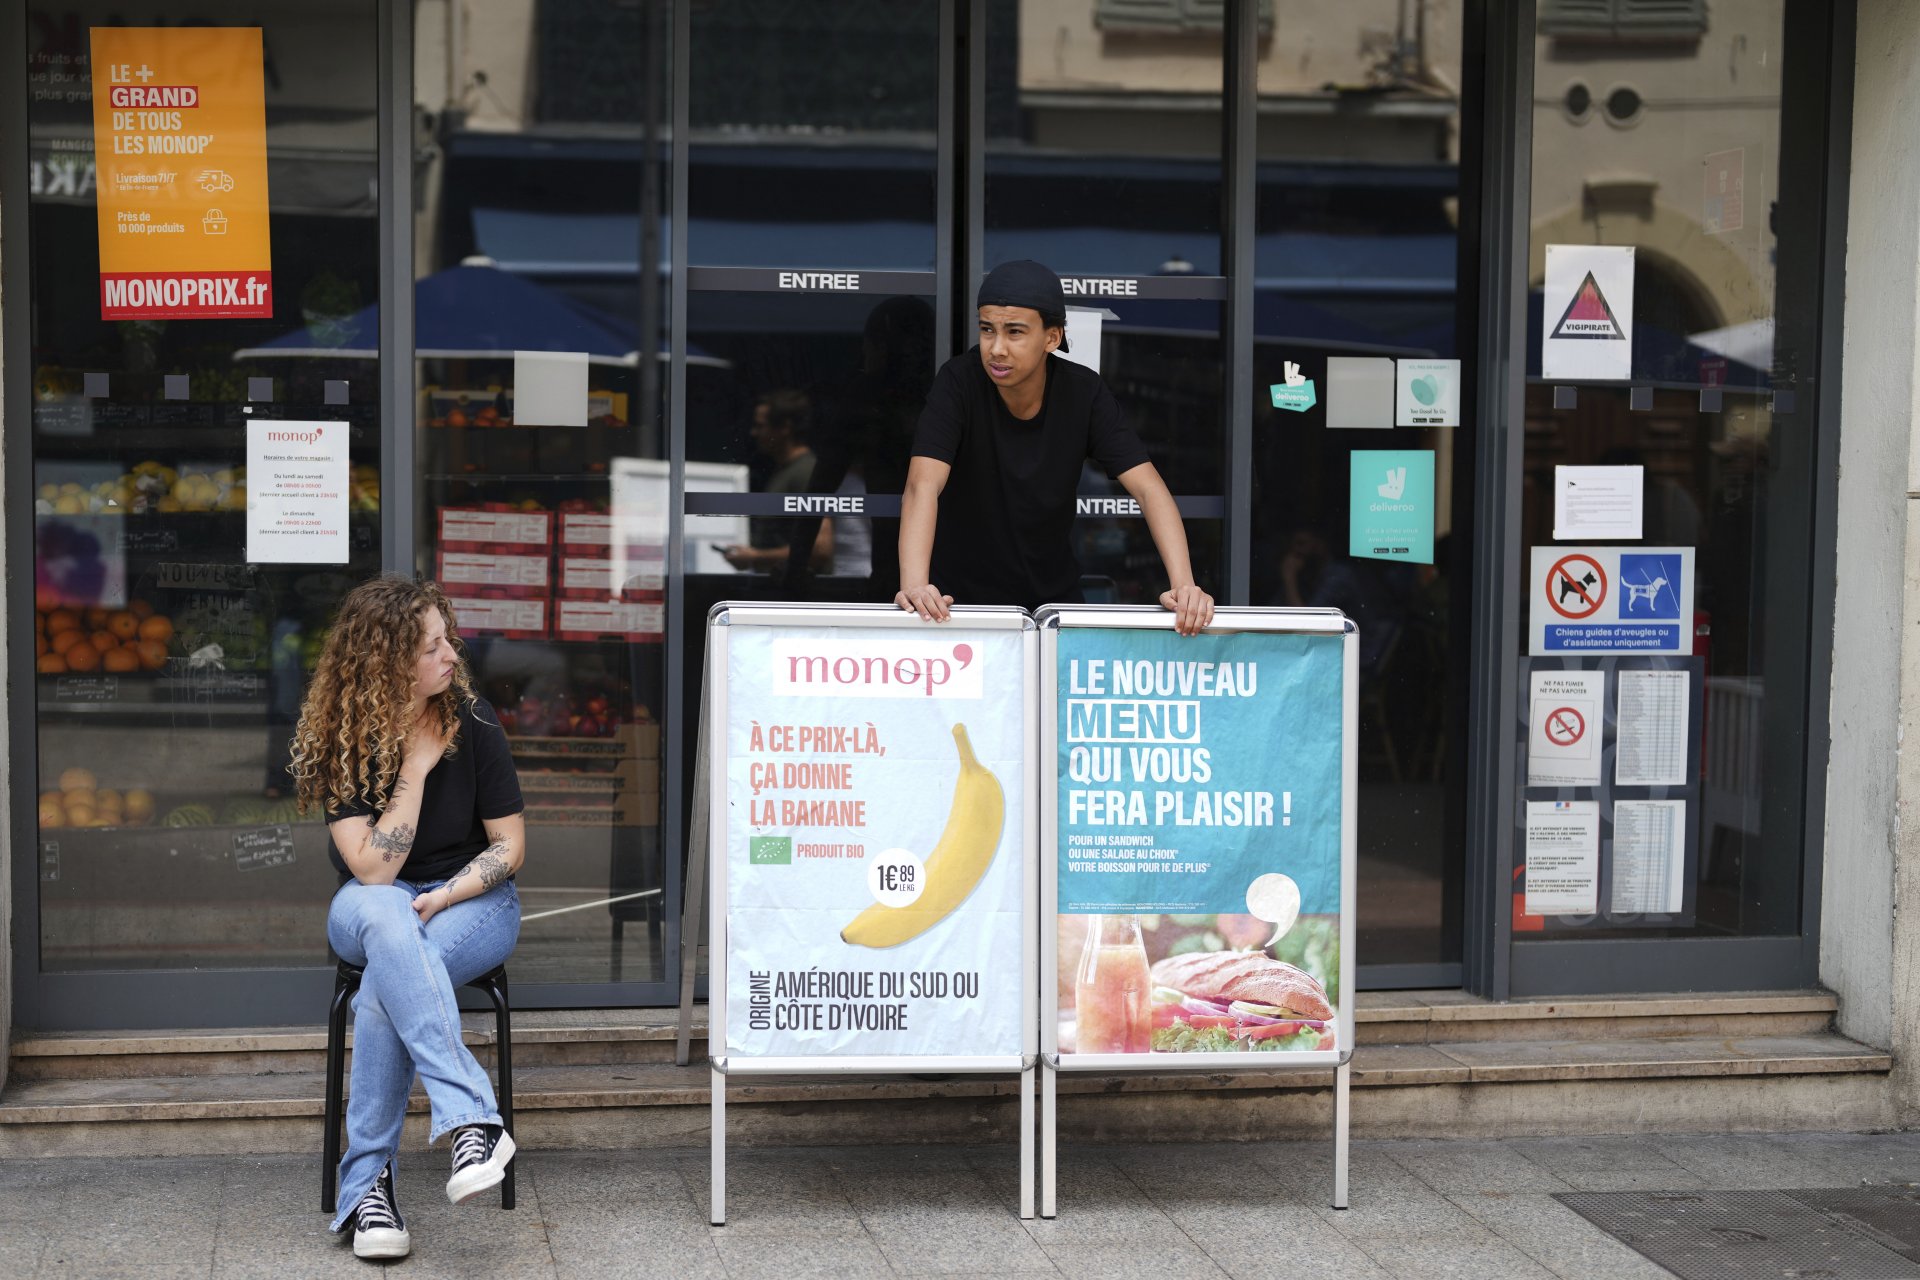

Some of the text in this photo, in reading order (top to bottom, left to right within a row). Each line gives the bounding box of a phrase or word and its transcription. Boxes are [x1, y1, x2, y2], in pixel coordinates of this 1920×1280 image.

[37, 52, 70, 64] fruits
[111, 64, 154, 82] LE +
[112, 87, 197, 107] GRAND
[113, 112, 182, 131] DE TOUS
[114, 135, 145, 155] LES
[116, 172, 158, 184] Livraison
[118, 211, 150, 222] Près de
[118, 222, 184, 236] 10 000 produits
[779, 272, 860, 290] ENTREE
[1060, 278, 1138, 296] ENTREE
[105, 276, 268, 308] MONOPRIX.fr
[1275, 392, 1310, 402] deliveroo
[784, 496, 864, 512] ENTREE
[1076, 498, 1142, 514] NTREE
[1370, 502, 1414, 512] deliveroo
[1556, 628, 1584, 636] Chiens
[1586, 628, 1612, 638] guides
[1614, 628, 1657, 638] d'aveugles
[1563, 638, 1661, 648] d'assistance uniquement
[1070, 659, 1257, 697] LE NOUVEAU
[1070, 702, 1198, 740] MENU
[750, 720, 886, 757] À CE PRIX-LÀ,
[1068, 746, 1212, 785] QUI VOUS
[750, 762, 852, 796] ÇA DONNE
[750, 799, 866, 827] LA BANANE
[1068, 790, 1148, 826] FERA
[1155, 790, 1274, 827] PLAISIR
[1068, 835, 1154, 846] POUR UN SANDWICH
[797, 844, 864, 859] PRODUIT BIO
[1068, 848, 1080, 859] OU
[1082, 849, 1100, 859] UNE
[1102, 849, 1136, 859] SALADE
[1136, 849, 1148, 859] AU
[1068, 862, 1097, 872] VOTRE
[1098, 862, 1136, 872] BOISSON
[1138, 862, 1160, 872] POUR
[1161, 862, 1171, 872] 1€
[1172, 862, 1184, 872] DE
[774, 966, 979, 1000] AMÉRIQUE DU SUD OU
[750, 970, 771, 1030] ORIGINE
[774, 1000, 908, 1031] CÔTE D'IVOIRE
